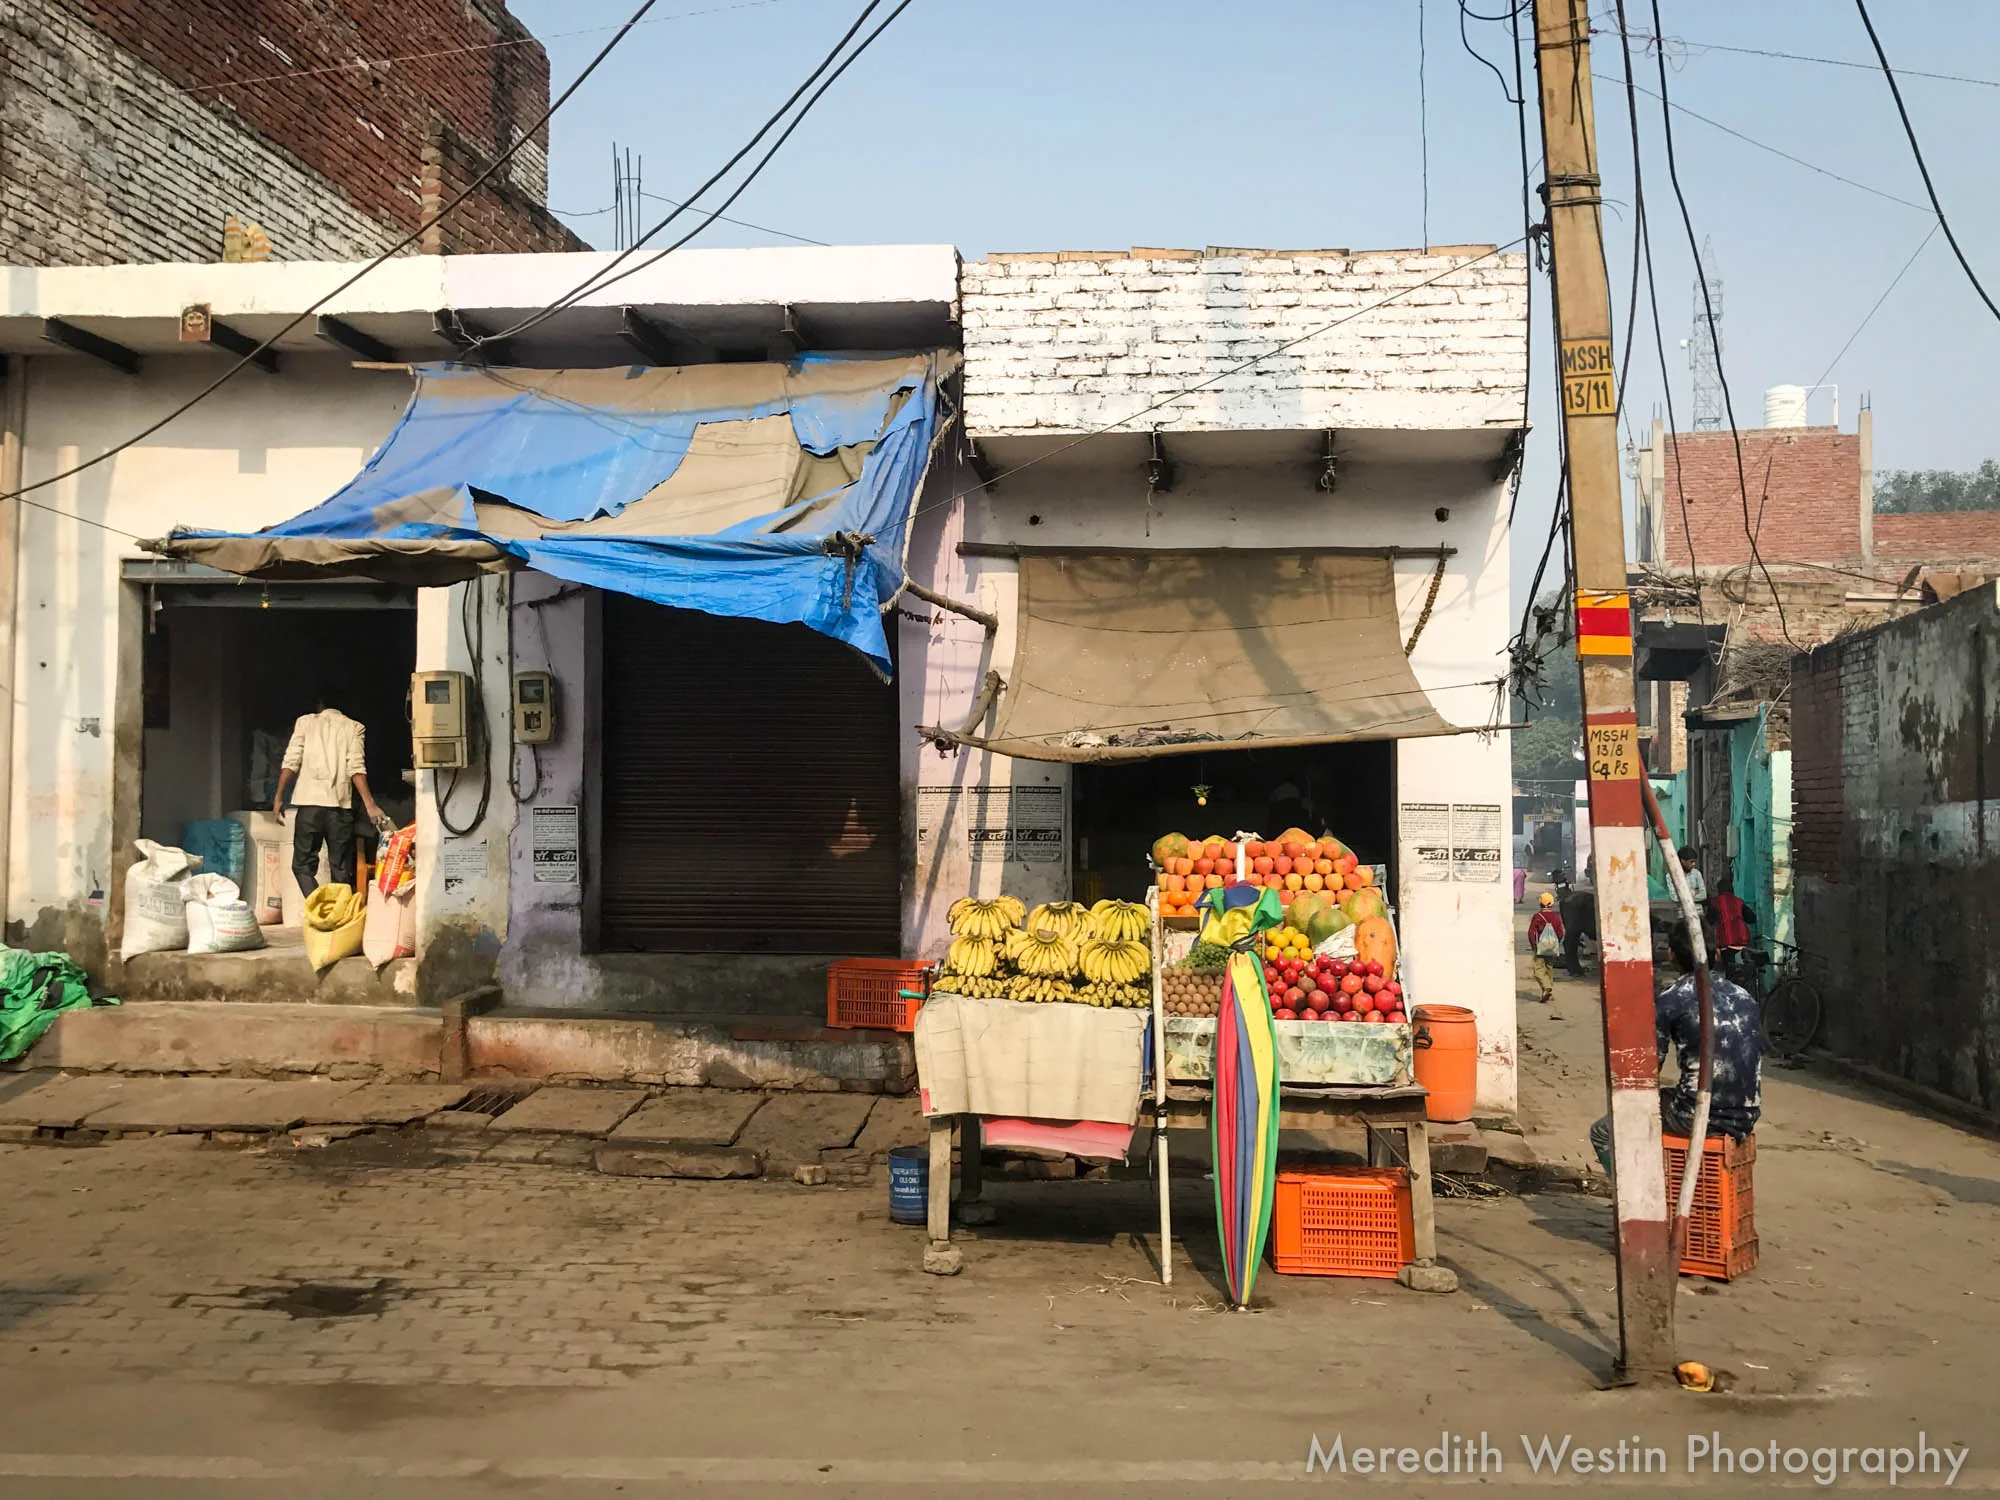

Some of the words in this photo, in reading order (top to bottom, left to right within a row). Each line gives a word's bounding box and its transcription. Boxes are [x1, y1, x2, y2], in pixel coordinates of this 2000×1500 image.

[1563, 345, 1611, 372] MSSH
[1564, 379, 1609, 413] 13/11
[1590, 730, 1628, 742] MSSH
[1597, 744, 1623, 757] 13/8
